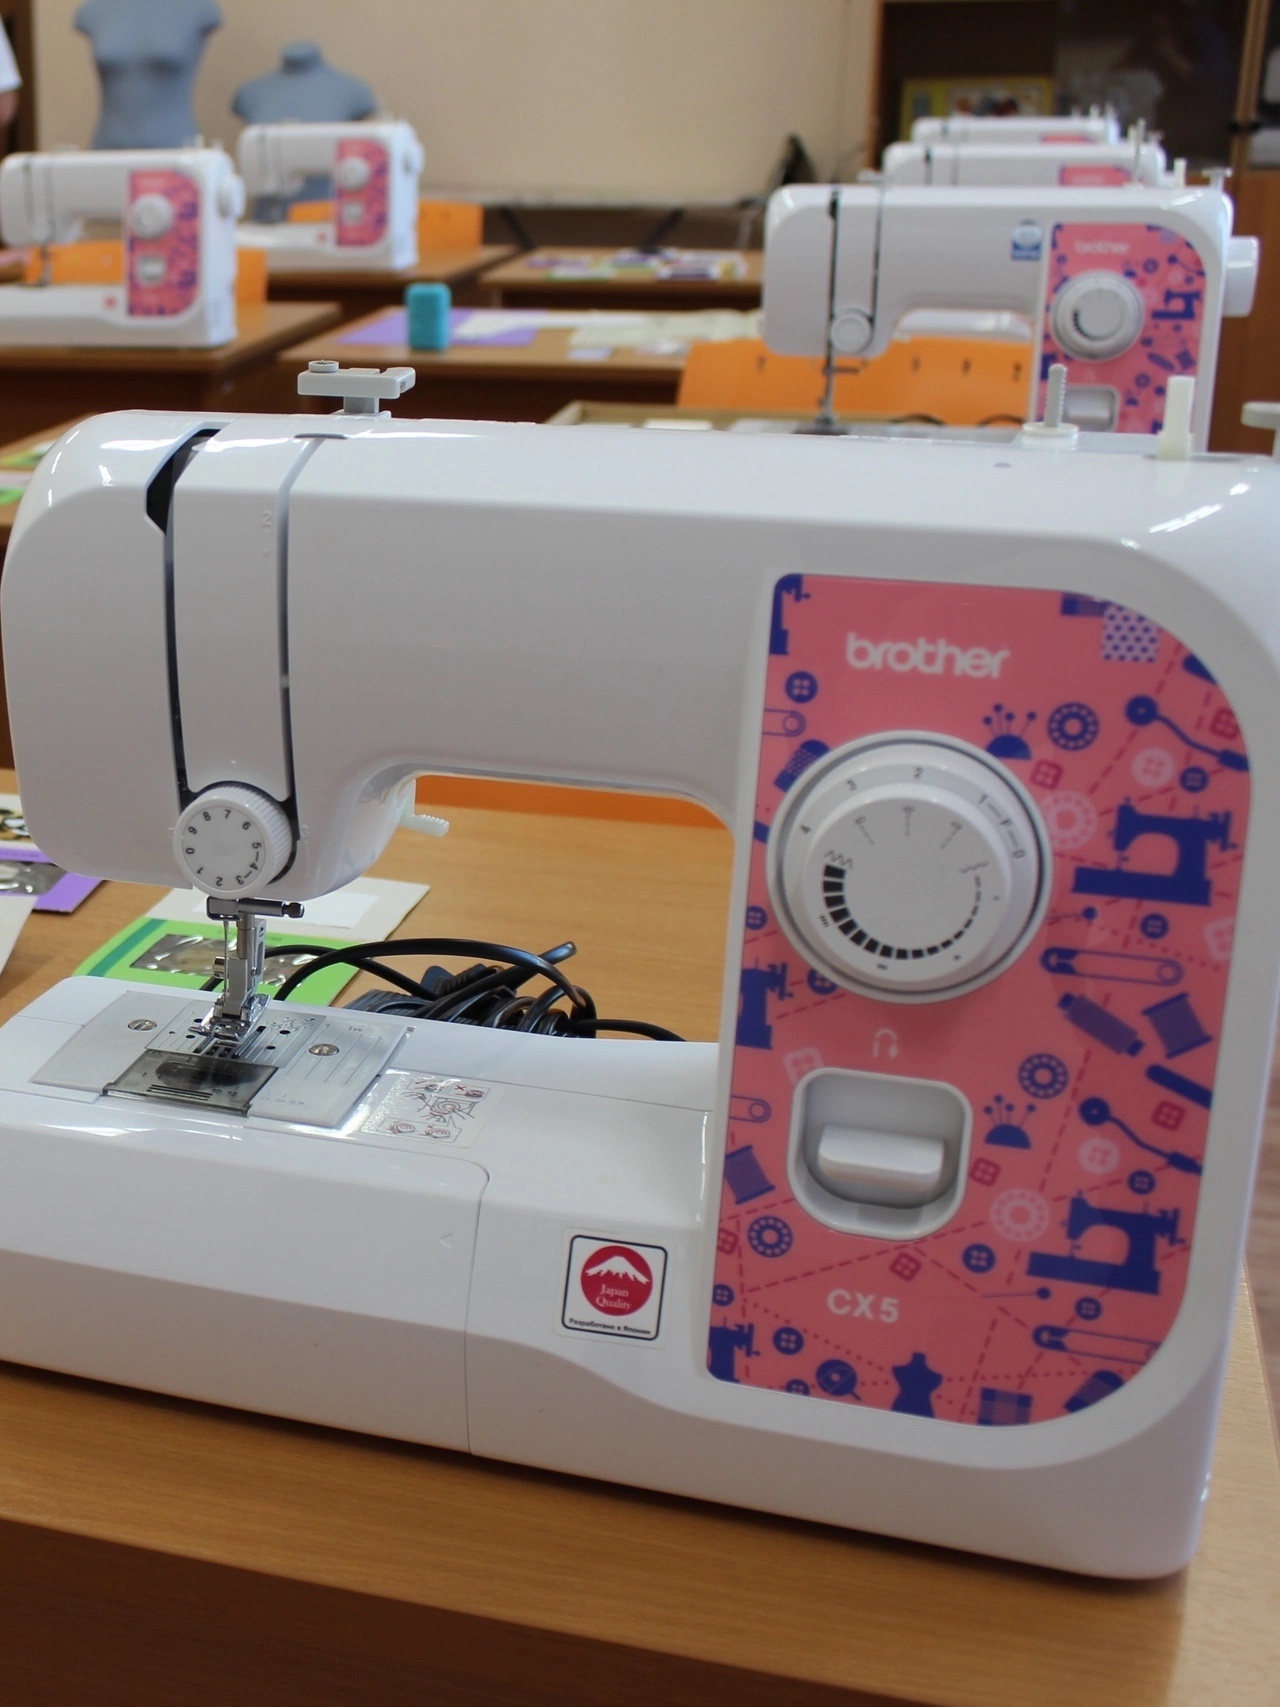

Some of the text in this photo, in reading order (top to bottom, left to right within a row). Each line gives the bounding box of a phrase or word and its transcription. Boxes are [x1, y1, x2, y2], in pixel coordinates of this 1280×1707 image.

[845, 632, 1010, 678] brother
[913, 767, 924, 779] 2
[202, 811, 212, 822] 8
[224, 809, 232, 819] 7
[188, 826, 198, 835] 9
[242, 821, 252, 831] 6
[185, 847, 195, 855] 0
[196, 866, 204, 875] 1
[250, 862, 259, 870] 4
[215, 876, 224, 887] 2
[235, 875, 245, 885] 3
[599, 1284, 629, 1297] Japan
[595, 1296, 632, 1311] Quality
[827, 1289, 900, 1323] CX5
